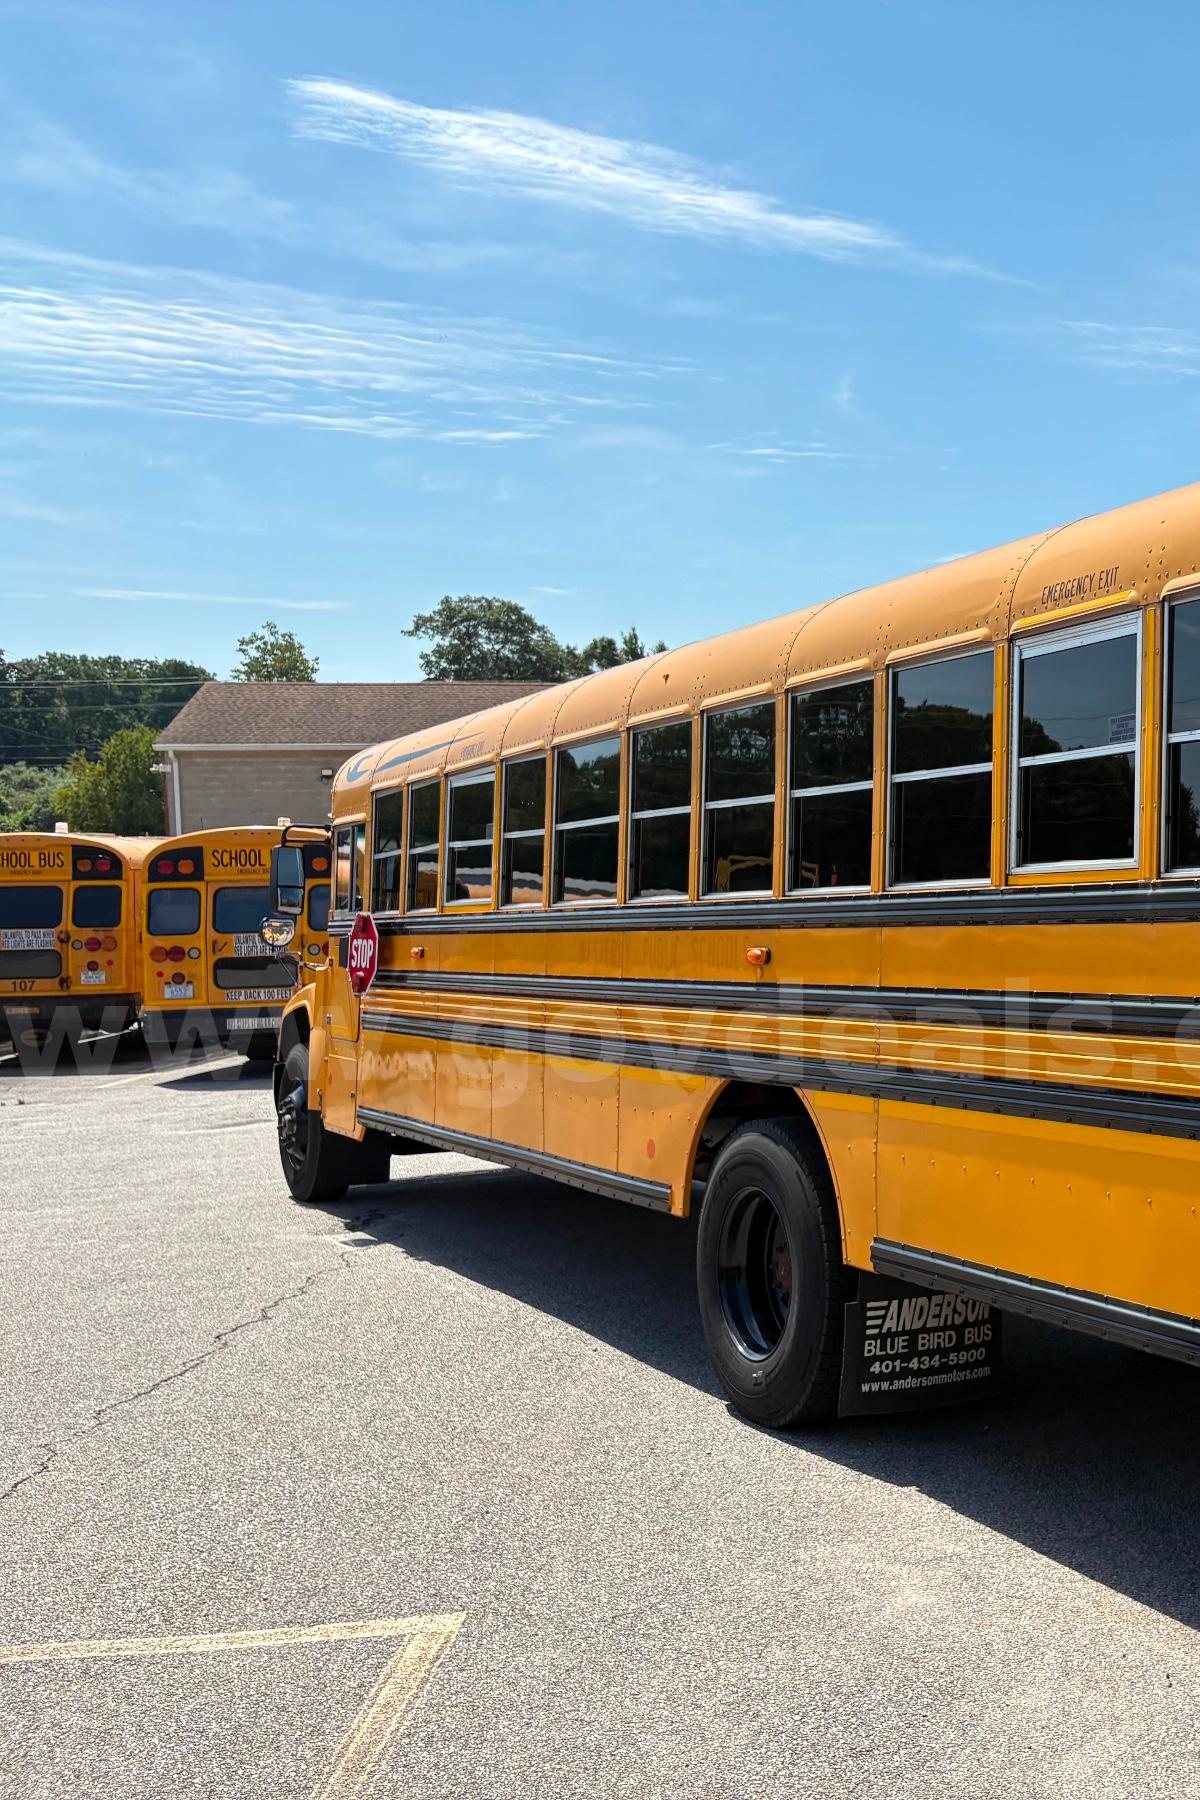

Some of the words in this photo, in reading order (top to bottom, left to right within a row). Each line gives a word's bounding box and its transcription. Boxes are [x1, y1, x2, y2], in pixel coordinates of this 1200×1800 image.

[1041, 573, 1096, 605] EMERGENCY
[1098, 566, 1120, 590] EXIT
[39, 851, 65, 868] BUS
[211, 849, 267, 868] SCHOOL
[351, 938, 374, 969] STOP
[11, 980, 36, 992] 107
[226, 990, 242, 1000] KEEP
[244, 990, 261, 1000] BACK
[264, 989, 275, 999] 100
[277, 989, 292, 999] FEET
[881, 1294, 991, 1334] ANDERSON
[864, 1336, 909, 1357] BLUE
[918, 1330, 956, 1350] BIRD
[964, 1324, 992, 1345] BUS
[869, 1348, 986, 1374] 401-434-5900
[861, 1366, 991, 1393] www.andersonmotors.com
